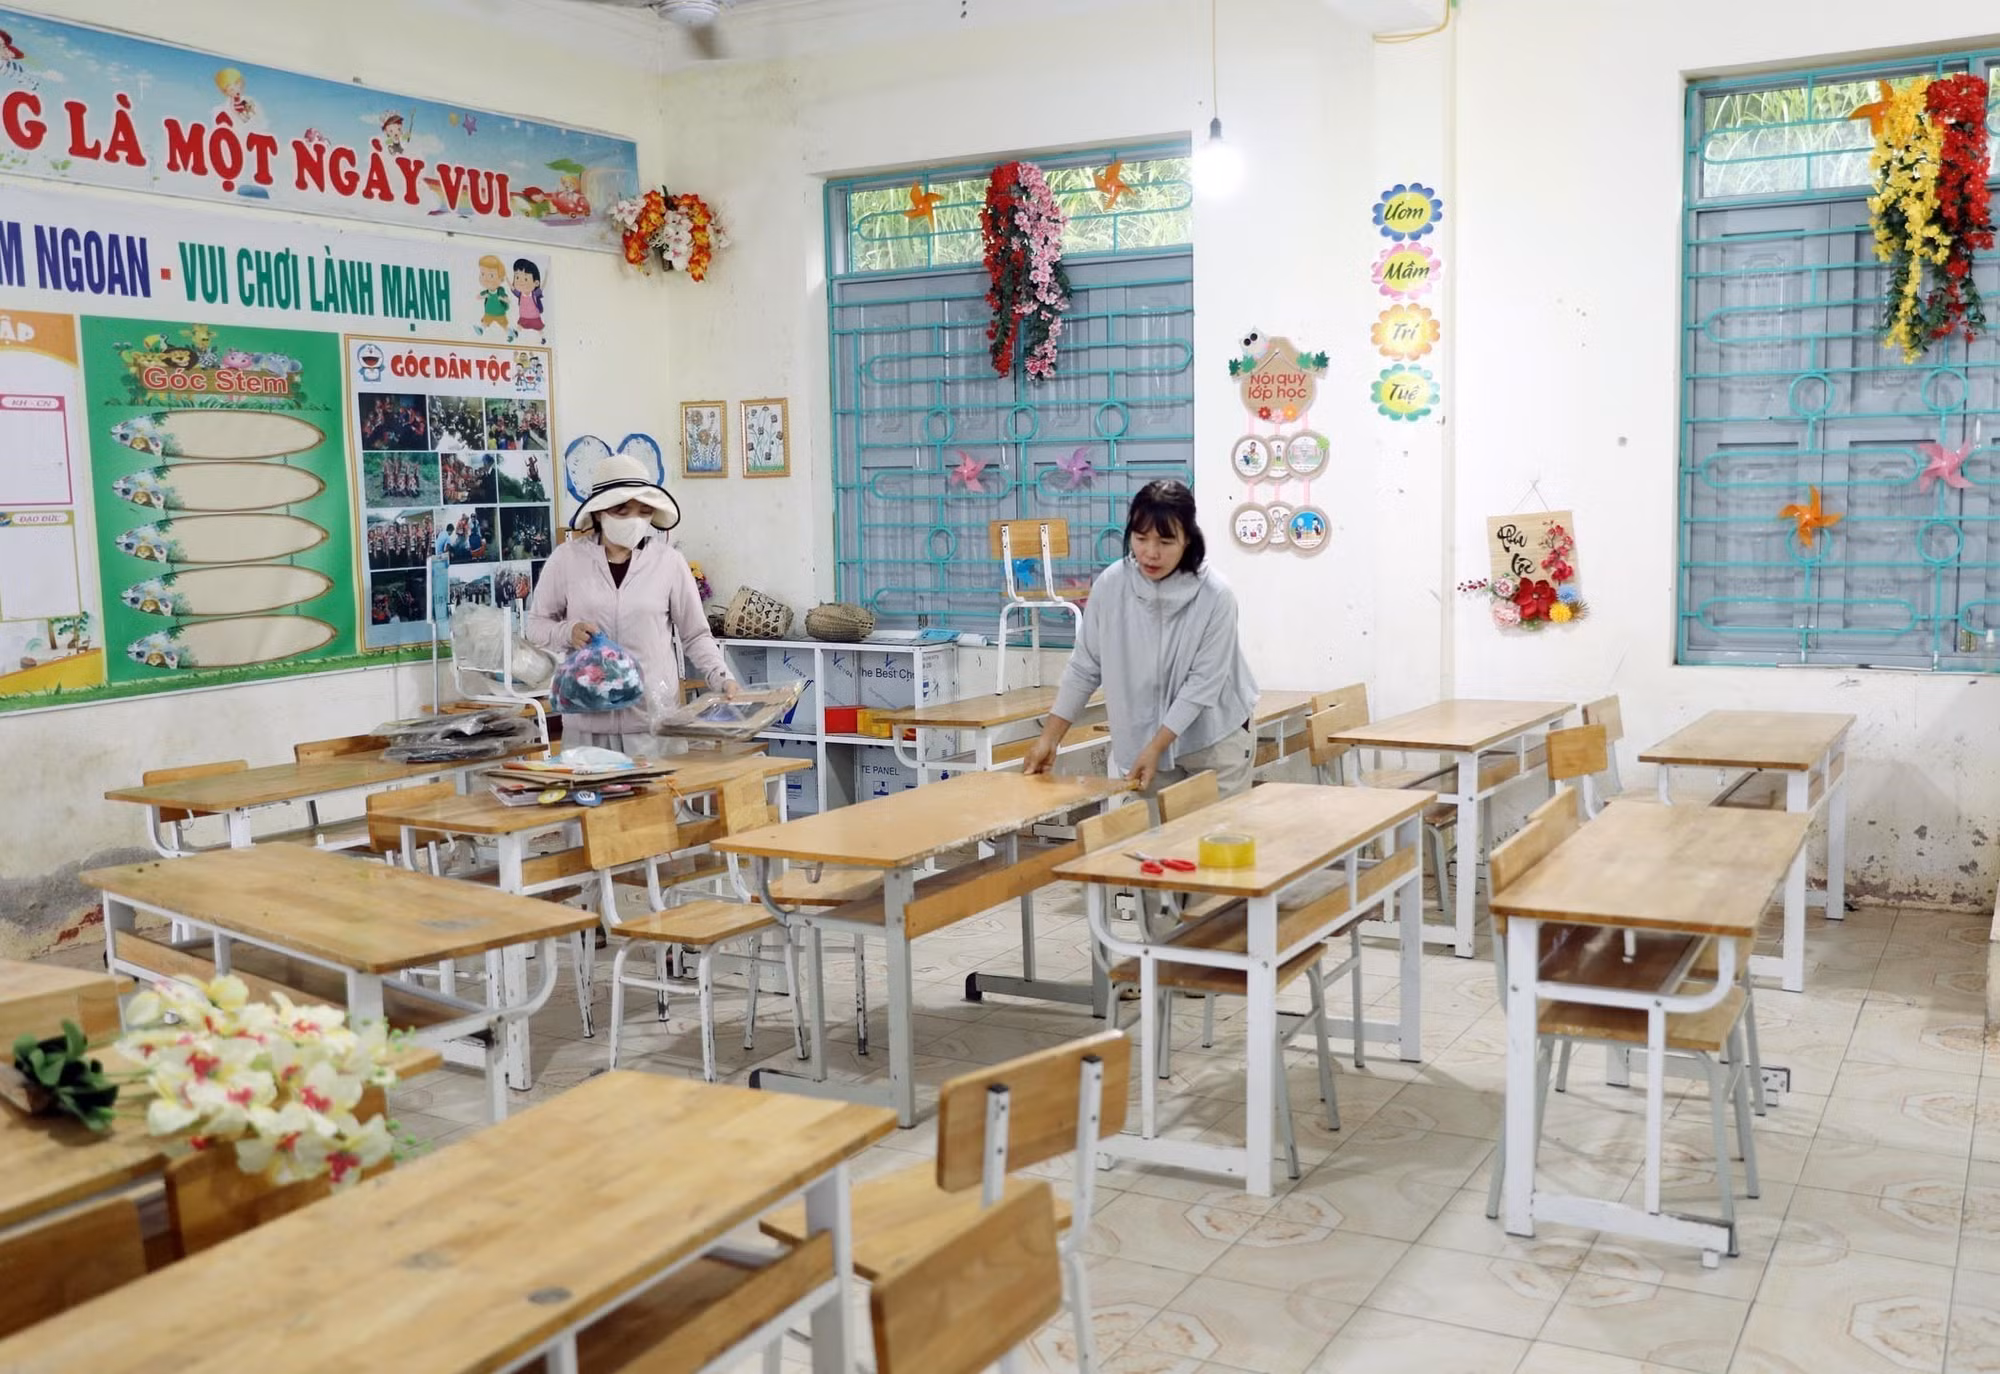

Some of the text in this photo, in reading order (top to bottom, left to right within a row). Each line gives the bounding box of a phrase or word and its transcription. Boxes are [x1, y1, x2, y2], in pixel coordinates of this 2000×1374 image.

[2, 91, 511, 217] G LÀ MỘT NGÀY VUI
[34, 224, 152, 298] NGOAN
[179, 242, 229, 304] VUI
[237, 248, 301, 310] CHƠI
[307, 247, 374, 315] LÀNH
[381, 263, 451, 331] MẠNH
[1384, 261, 1430, 280] Mầm
[1392, 322, 1419, 341] Trí
[391, 350, 512, 382] GÓC DÂN TỘC
[144, 367, 288, 393] Góc Stem
[1277, 373, 1306, 386] quy
[1248, 385, 1306, 402] lớp học
[1390, 383, 1420, 404] Tuệ
[876, 667, 897, 679] Best
[873, 765, 900, 777] PANEL
